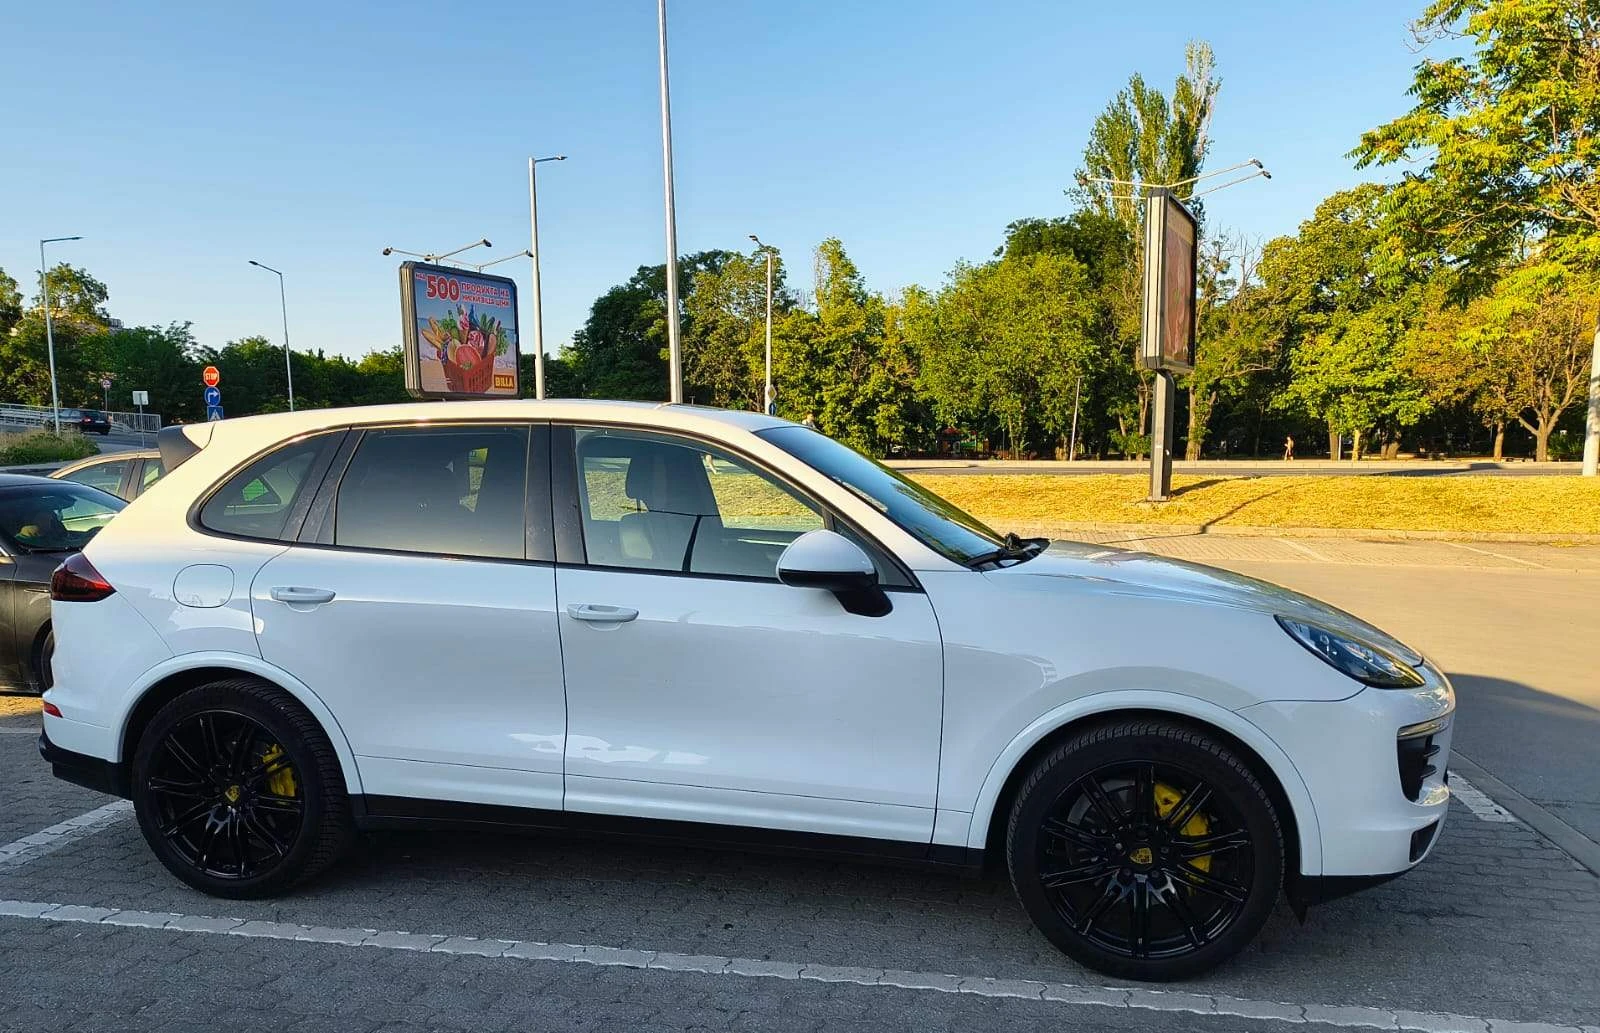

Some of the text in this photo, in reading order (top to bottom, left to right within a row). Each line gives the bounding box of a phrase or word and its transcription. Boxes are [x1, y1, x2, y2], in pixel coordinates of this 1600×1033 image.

[427, 275, 460, 301] 500
[461, 282, 498, 296] ПРОДУКТА
[499, 288, 510, 298] НА
[495, 376, 514, 387] BILLA
